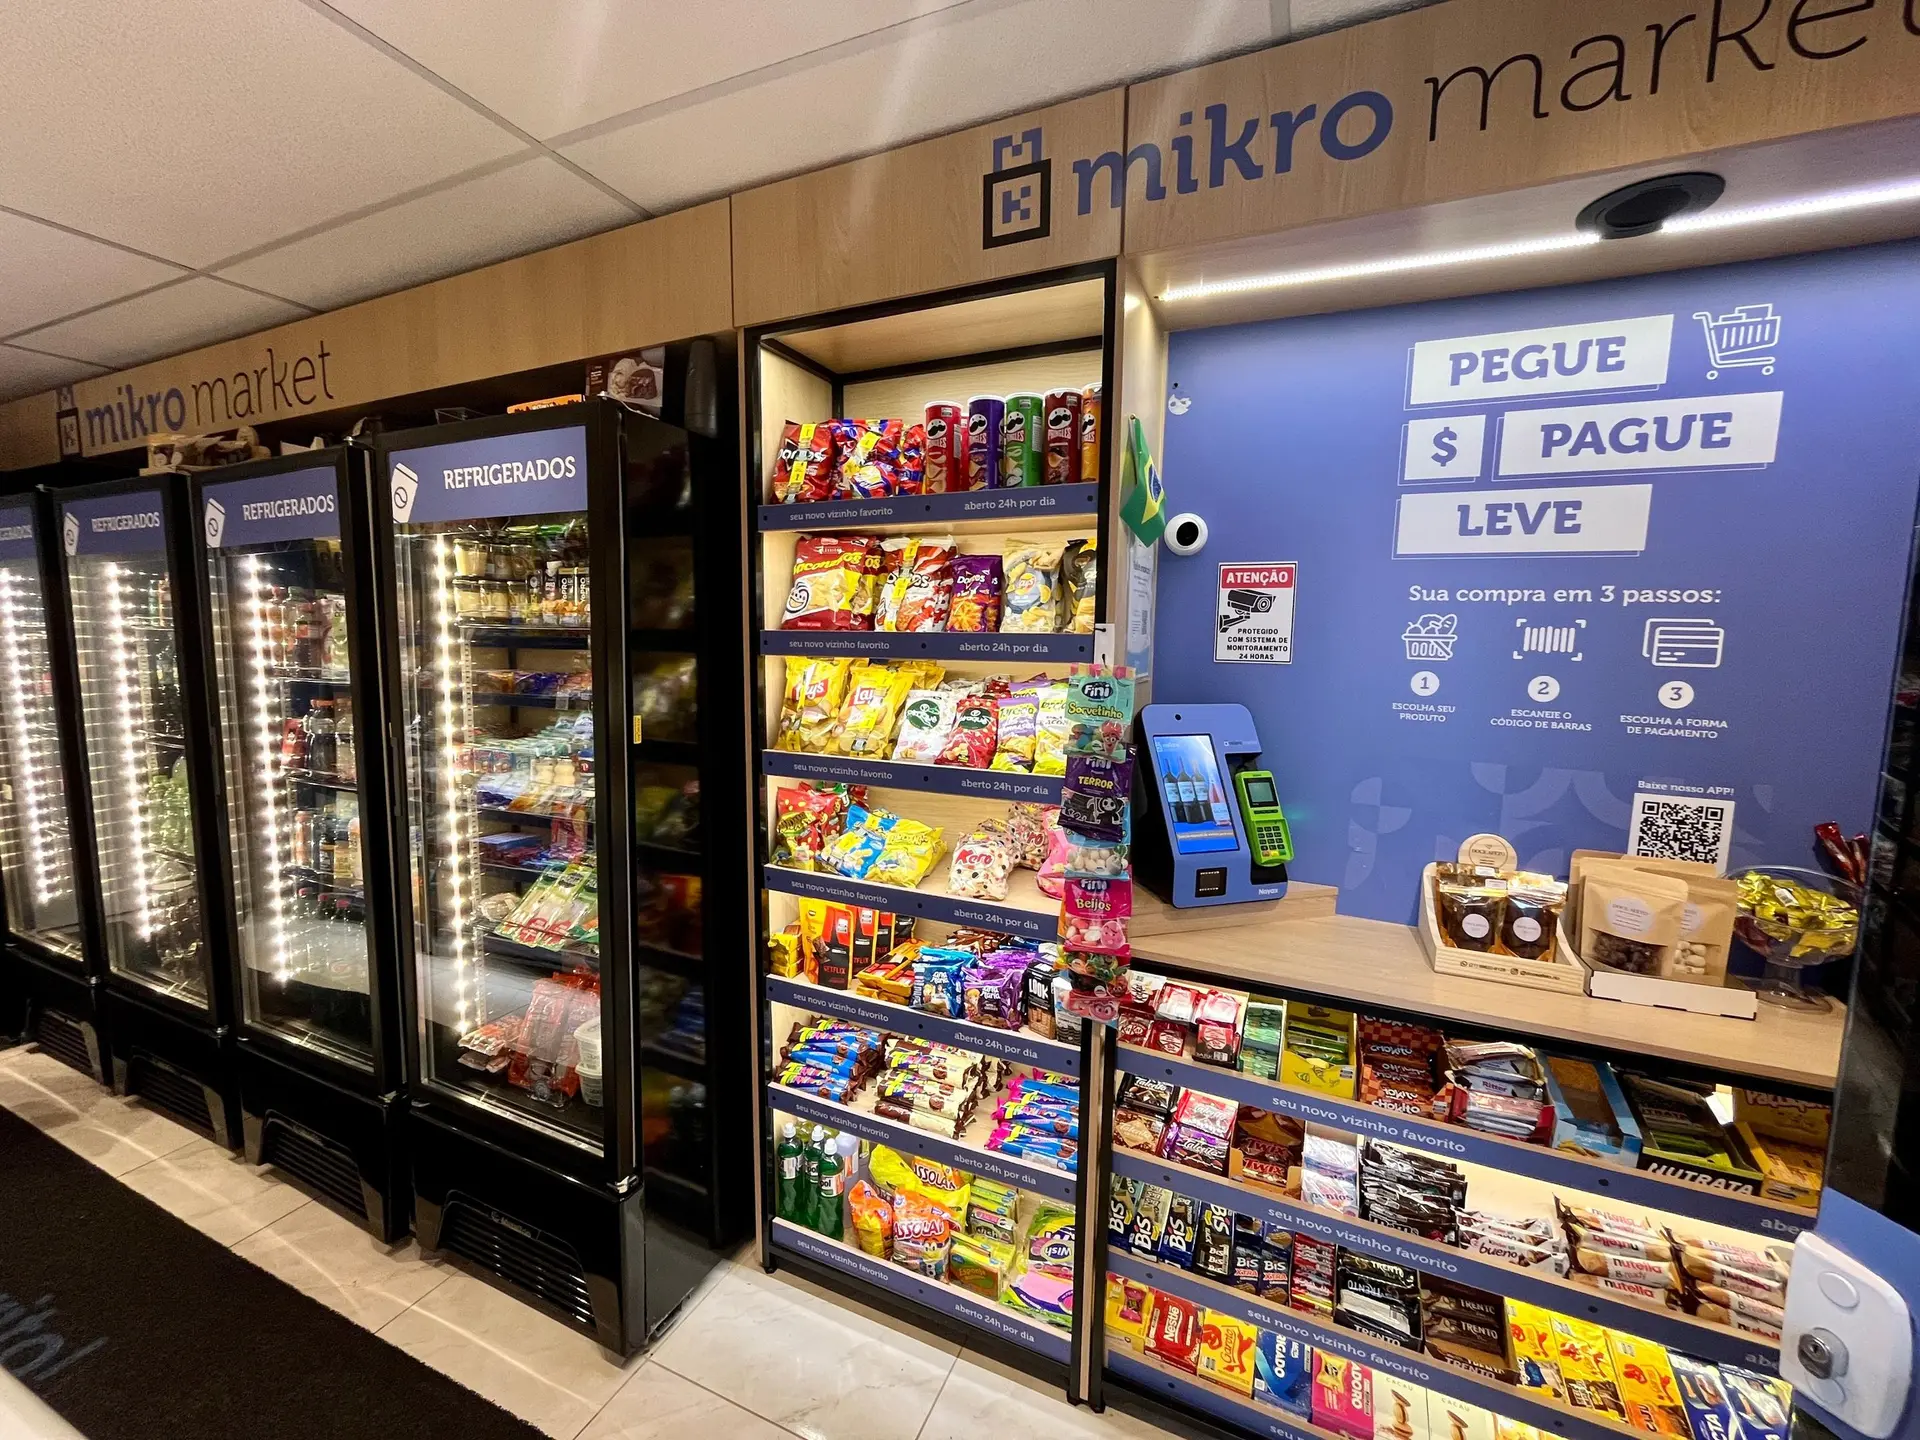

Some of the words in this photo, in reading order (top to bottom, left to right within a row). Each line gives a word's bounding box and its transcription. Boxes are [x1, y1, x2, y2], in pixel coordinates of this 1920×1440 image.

[1074, 90, 1393, 216] mikro
[1449, 335, 1627, 386] PEGUE
[85, 384, 187, 448] mikro
[192, 340, 334, 426] market
[1431, 427, 1458, 467] $
[1540, 411, 1733, 458] PAGUE
[443, 455, 577, 490] REFRIGERADOS
[243, 494, 335, 522] REFRIGERADOS
[964, 501, 996, 511] aberto
[998, 499, 1017, 508] 24h
[1019, 500, 1037, 511] por
[1039, 497, 1056, 506] dia
[91, 512, 160, 533] REFRIGERADOS
[790, 512, 803, 521] seu
[805, 512, 825, 520] novo
[827, 509, 858, 519] vizinho
[859, 507, 893, 517] favorito
[1456, 500, 1583, 537] LEVE
[1226, 569, 1289, 586] ATENÇÃO
[1408, 585, 1449, 602] Sua
[1456, 587, 1546, 606] compra
[1553, 587, 1593, 602] em
[1600, 585, 1615, 603] 3
[1623, 587, 1722, 606] passos:
[825, 640, 856, 649] vizinho
[857, 641, 890, 650] favorito
[959, 643, 990, 652] aberto
[992, 643, 1011, 652] 24h
[1013, 645, 1030, 654] por
[1032, 644, 1049, 653] dia
[1226, 644, 1288, 652] MONITORAMENTO
[1084, 683, 1111, 697] Fini
[1420, 676, 1430, 690] 1
[1537, 681, 1550, 696] 2
[1670, 686, 1682, 701] 3
[1068, 702, 1124, 719] Sorvetinho
[1392, 703, 1435, 712] ESCOLHA
[1437, 704, 1456, 713] SEU
[1511, 709, 1560, 720] ESCANEIE
[1563, 711, 1572, 720] O
[1399, 713, 1446, 723] PRODUTO
[1490, 717, 1532, 728] CÓDIGO
[1535, 720, 1549, 729] DE
[1551, 721, 1592, 731] BARRAS
[1620, 715, 1672, 725] ESCOLHA
[1674, 718, 1683, 726] A
[1686, 719, 1728, 729] FORMA
[1627, 726, 1642, 735] DE
[1644, 727, 1718, 739] PAGAMENTO
[793, 763, 807, 771] seu
[808, 765, 828, 774] novo
[829, 766, 859, 776] vizinho
[860, 769, 893, 779] favorito
[961, 779, 991, 789] aberto
[993, 782, 1012, 791] 24h
[1014, 784, 1031, 795] por
[1032, 785, 1049, 795] dia
[1078, 776, 1114, 789] TERROR
[1638, 780, 1667, 790] Baixe
[1670, 783, 1704, 793] nosso
[1706, 786, 1735, 796] APP!
[955, 848, 994, 866] Kero
[791, 881, 805, 889] seu
[806, 884, 825, 893] novo
[826, 886, 855, 898] vizinho
[856, 892, 888, 904] favorito
[1076, 898, 1112, 911] Beijos
[954, 909, 984, 920] aberto
[985, 913, 1003, 924] 24h
[1005, 918, 1022, 929] por
[1023, 919, 1039, 930] dia
[1028, 978, 1049, 998] LOOK
[793, 993, 807, 1002] seu
[807, 996, 827, 1007] novo
[828, 1000, 857, 1014] vizinho
[857, 1008, 889, 1022] favorito
[954, 1032, 983, 1046] aberto
[985, 1038, 1003, 1050] 24h
[1004, 1044, 1021, 1055] por
[1023, 1048, 1038, 1059] dia
[1482, 1080, 1508, 1092] Ritter
[796, 1104, 809, 1113] seu
[810, 1108, 828, 1120] novo
[830, 1114, 858, 1130] vizinho
[859, 1124, 890, 1139] favorito
[1272, 1096, 1297, 1110] seu
[1300, 1103, 1338, 1120] novo
[1341, 1114, 1398, 1136] vizinho
[1402, 1127, 1467, 1153] favorito
[954, 1154, 983, 1169] aberto
[984, 1162, 1003, 1175] 24h
[1003, 1168, 1020, 1181] por
[1021, 1173, 1037, 1185] dia
[1649, 1161, 1754, 1196] NUTRATA
[1760, 1217, 1800, 1235] abe
[1267, 1207, 1293, 1221] seu
[1296, 1217, 1333, 1235] novo
[1335, 1228, 1392, 1253] vizinho
[1395, 1245, 1458, 1273] favorito
[1479, 1242, 1518, 1258] bueno
[797, 1240, 810, 1249] seu
[811, 1245, 829, 1257] novo
[830, 1252, 858, 1269] vizinho
[859, 1263, 889, 1281] favorito
[1613, 1258, 1662, 1274] nutella
[1604, 1279, 1655, 1298] nutella
[954, 1303, 983, 1320] aberto
[984, 1316, 1001, 1329] 24h
[1002, 1322, 1019, 1336] por
[1020, 1330, 1035, 1342] dia
[1163, 1304, 1180, 1342] Nestlé
[1461, 1320, 1499, 1340] TRENTO
[1353, 1323, 1401, 1347] TRENTO
[1220, 1327, 1235, 1364] Garoto
[1247, 1308, 1273, 1323] seu
[1275, 1319, 1309, 1337] novo
[1313, 1330, 1367, 1358] vizinho
[1370, 1351, 1430, 1381] favorito
[1350, 1361, 1363, 1409] ADORO
[1386, 1377, 1414, 1391] CACAU
[1441, 1397, 1471, 1412] CACAU
